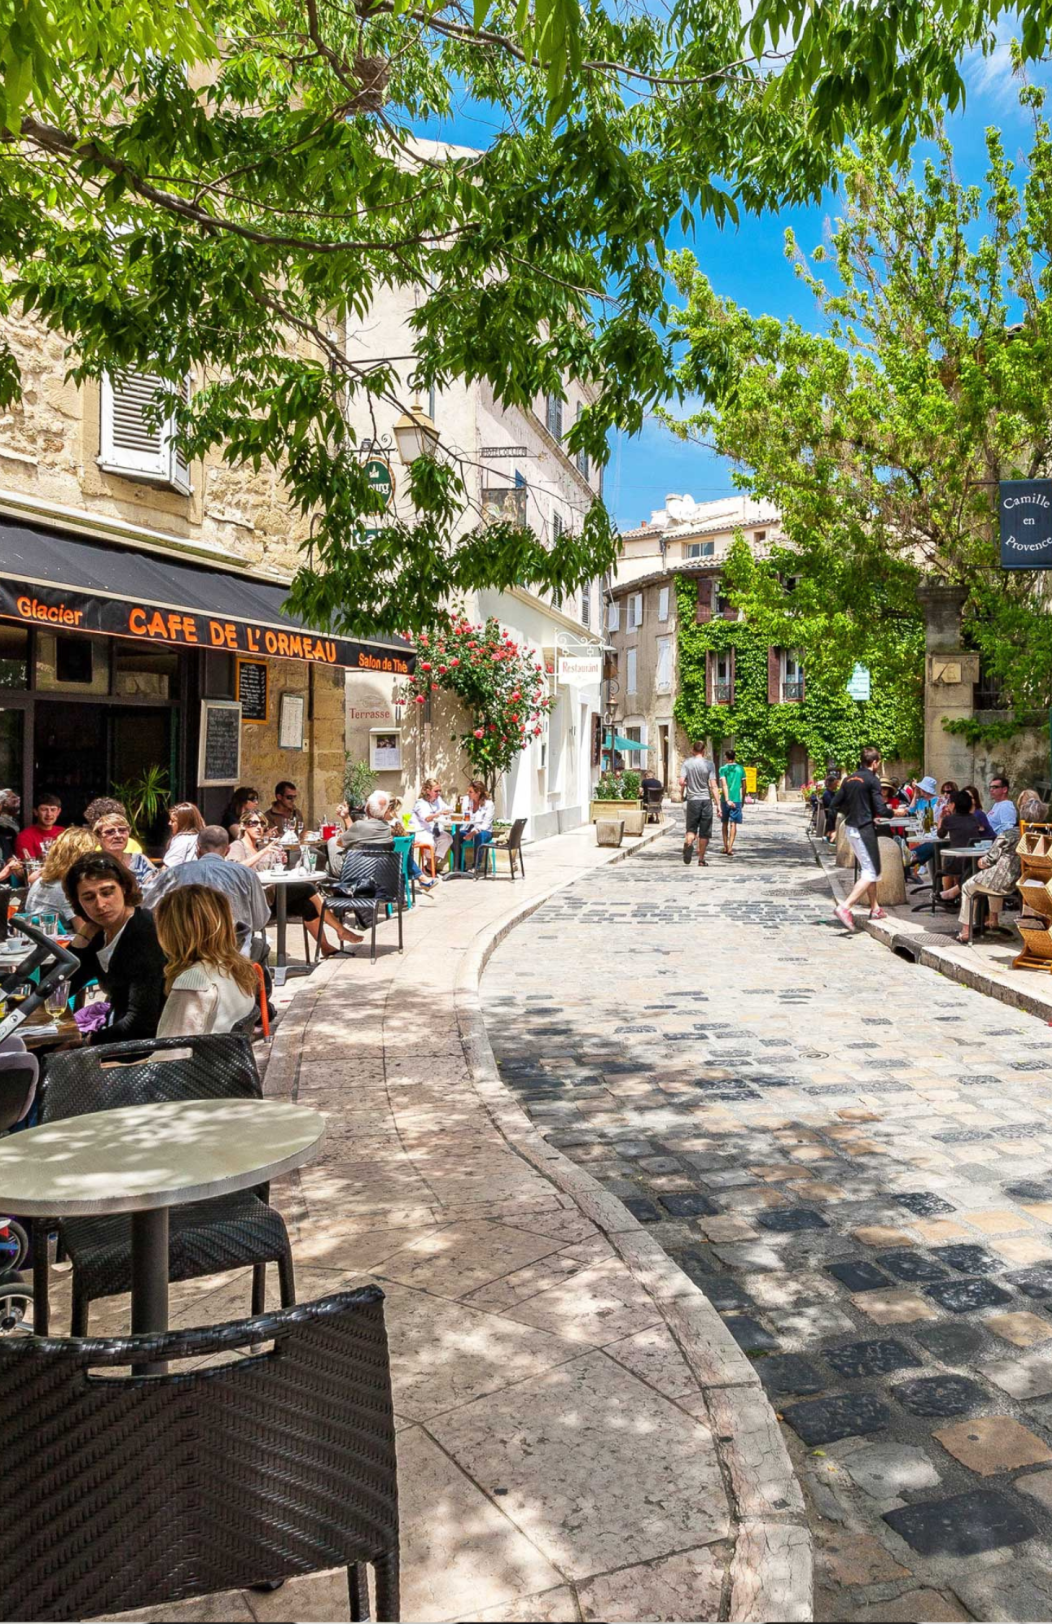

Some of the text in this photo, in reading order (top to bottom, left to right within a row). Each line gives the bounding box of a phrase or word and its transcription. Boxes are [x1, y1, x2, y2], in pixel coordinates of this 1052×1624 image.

[1003, 493, 1050, 509] Camille
[1023, 517, 1036, 525] en
[1005, 535, 1052, 551] Provence
[16, 596, 83, 625] Glacier
[209, 620, 238, 649] DE
[358, 652, 381, 669] Salon
[382, 657, 392, 671] de
[562, 661, 599, 673] Restaurant
[349, 707, 390, 719] Terrasse
